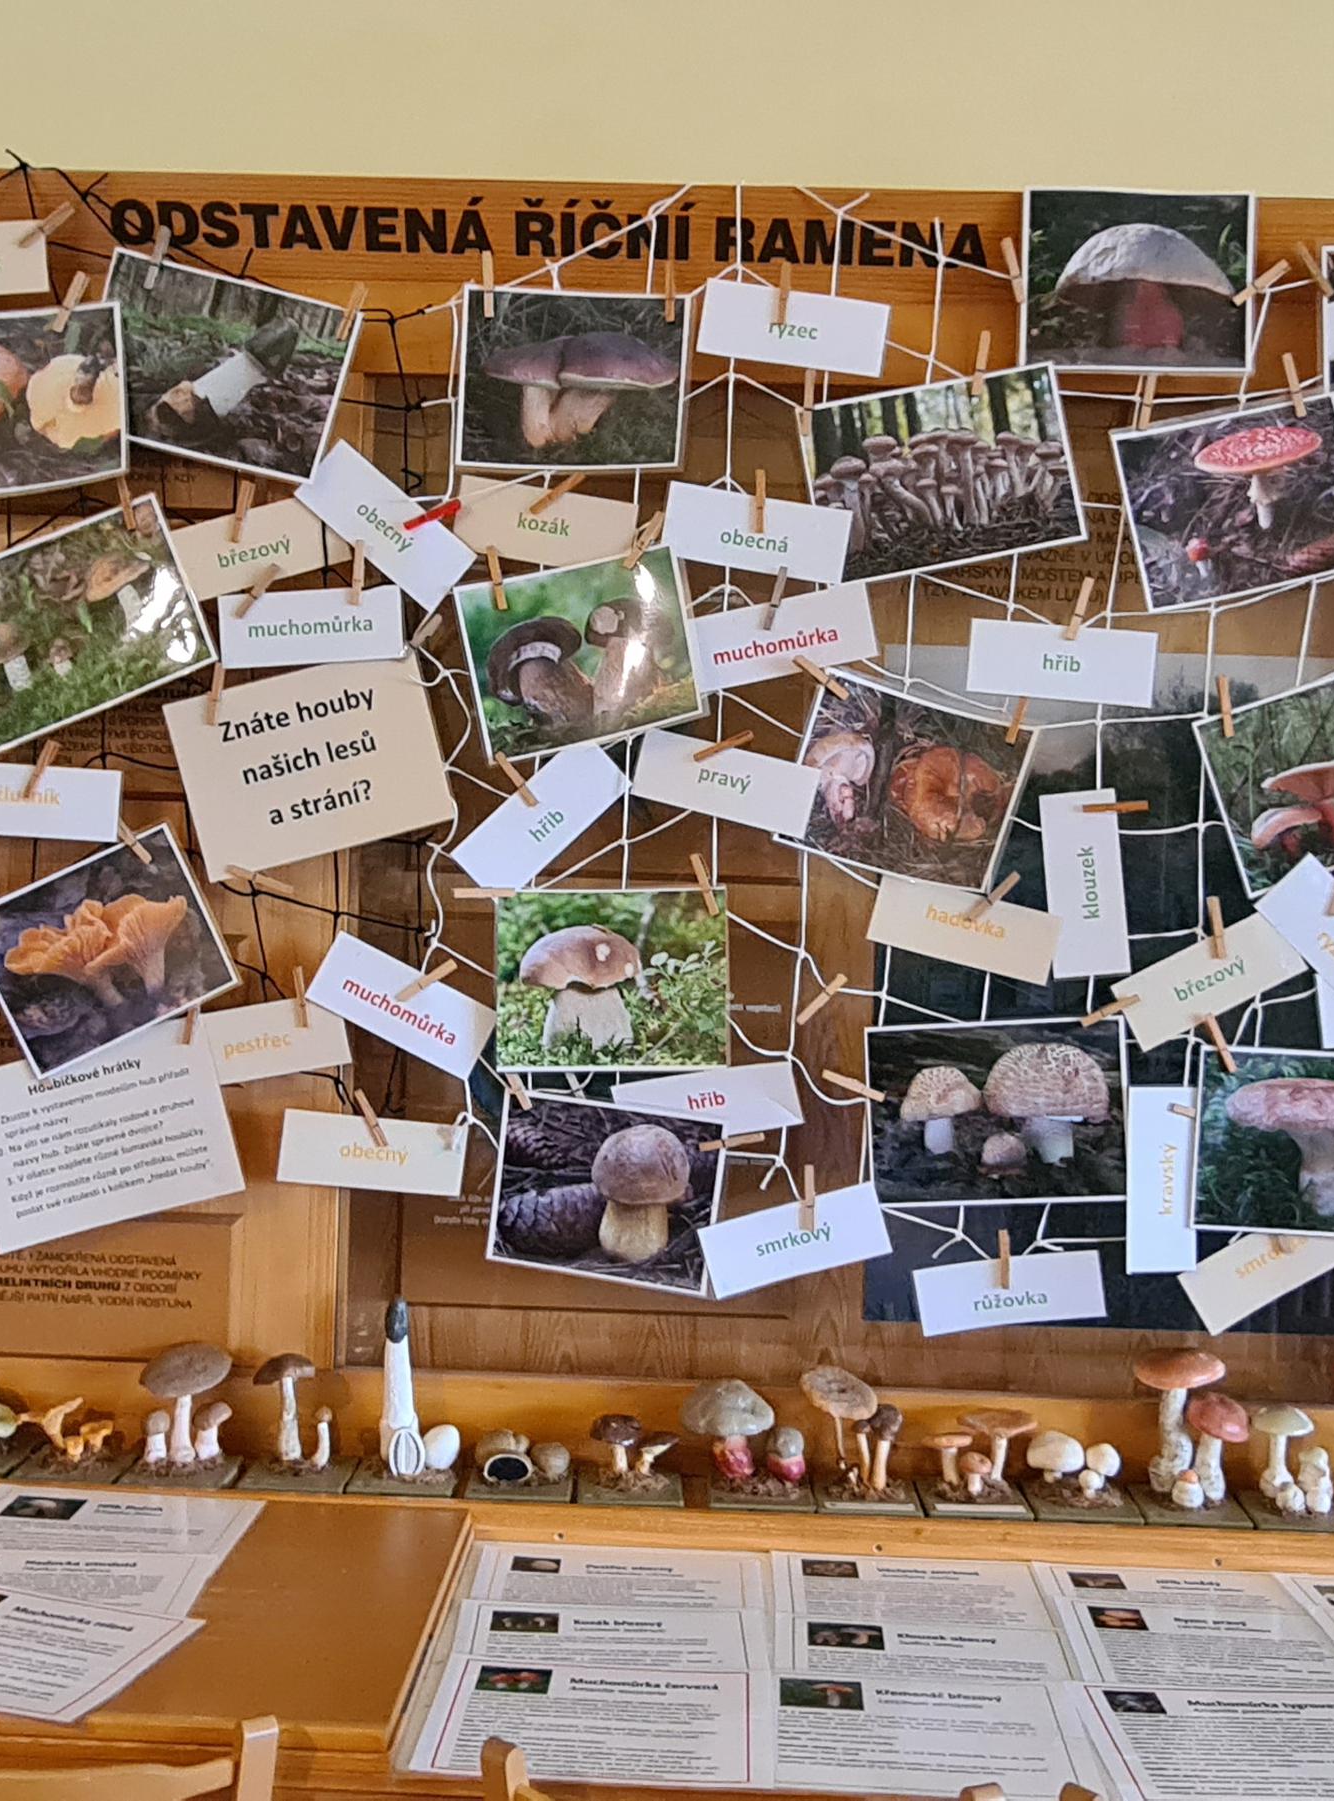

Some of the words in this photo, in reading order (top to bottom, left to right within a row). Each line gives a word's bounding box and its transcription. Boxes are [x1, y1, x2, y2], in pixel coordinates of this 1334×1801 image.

[110, 197, 490, 254] ODSTAVENÁ
[515, 198, 691, 262] ŘÍČNÍ
[714, 216, 988, 267] RAMENA
[769, 322, 818, 340] ryzec
[355, 500, 415, 553] obecný
[517, 512, 570, 537] kozák
[719, 529, 789, 554] obecná
[217, 535, 291, 569] březový
[248, 615, 374, 638] muchomůrka
[713, 626, 839, 665] muchomůrka
[1042, 653, 1082, 675] hřib
[219, 711, 291, 744] Znáte
[294, 686, 375, 724] houby
[241, 748, 322, 787] našich
[326, 731, 377, 763] lesů
[698, 766, 752, 794] pravý
[268, 807, 284, 826] a
[290, 779, 373, 821] strání?
[528, 808, 565, 844] hřib
[1082, 845, 1096, 920] klouzek
[926, 903, 1005, 938] hadovka
[1174, 955, 1247, 1003] březový
[342, 976, 457, 1047] muchomůrka
[223, 1032, 293, 1060] pestřec
[27, 1067, 101, 1096] Houbičkové
[101, 1056, 142, 1078] hrátky
[39, 1092, 94, 1114] vystaveným
[686, 1089, 726, 1111] hřib
[3, 1122, 41, 1140] správné
[51, 1129, 71, 1141] nám
[118, 1108, 150, 1124] rodové
[158, 1097, 195, 1114] druhové
[12, 1154, 40, 1169] názvy
[62, 1140, 90, 1154] Znáte
[90, 1130, 126, 1147] správné
[127, 1119, 164, 1137] dvojice?
[339, 1141, 408, 1167] obecný
[119, 1165, 132, 1175] po
[1158, 1142, 1178, 1216] kravský
[755, 1222, 831, 1257] smrkový
[973, 1287, 1048, 1313] růžovka
